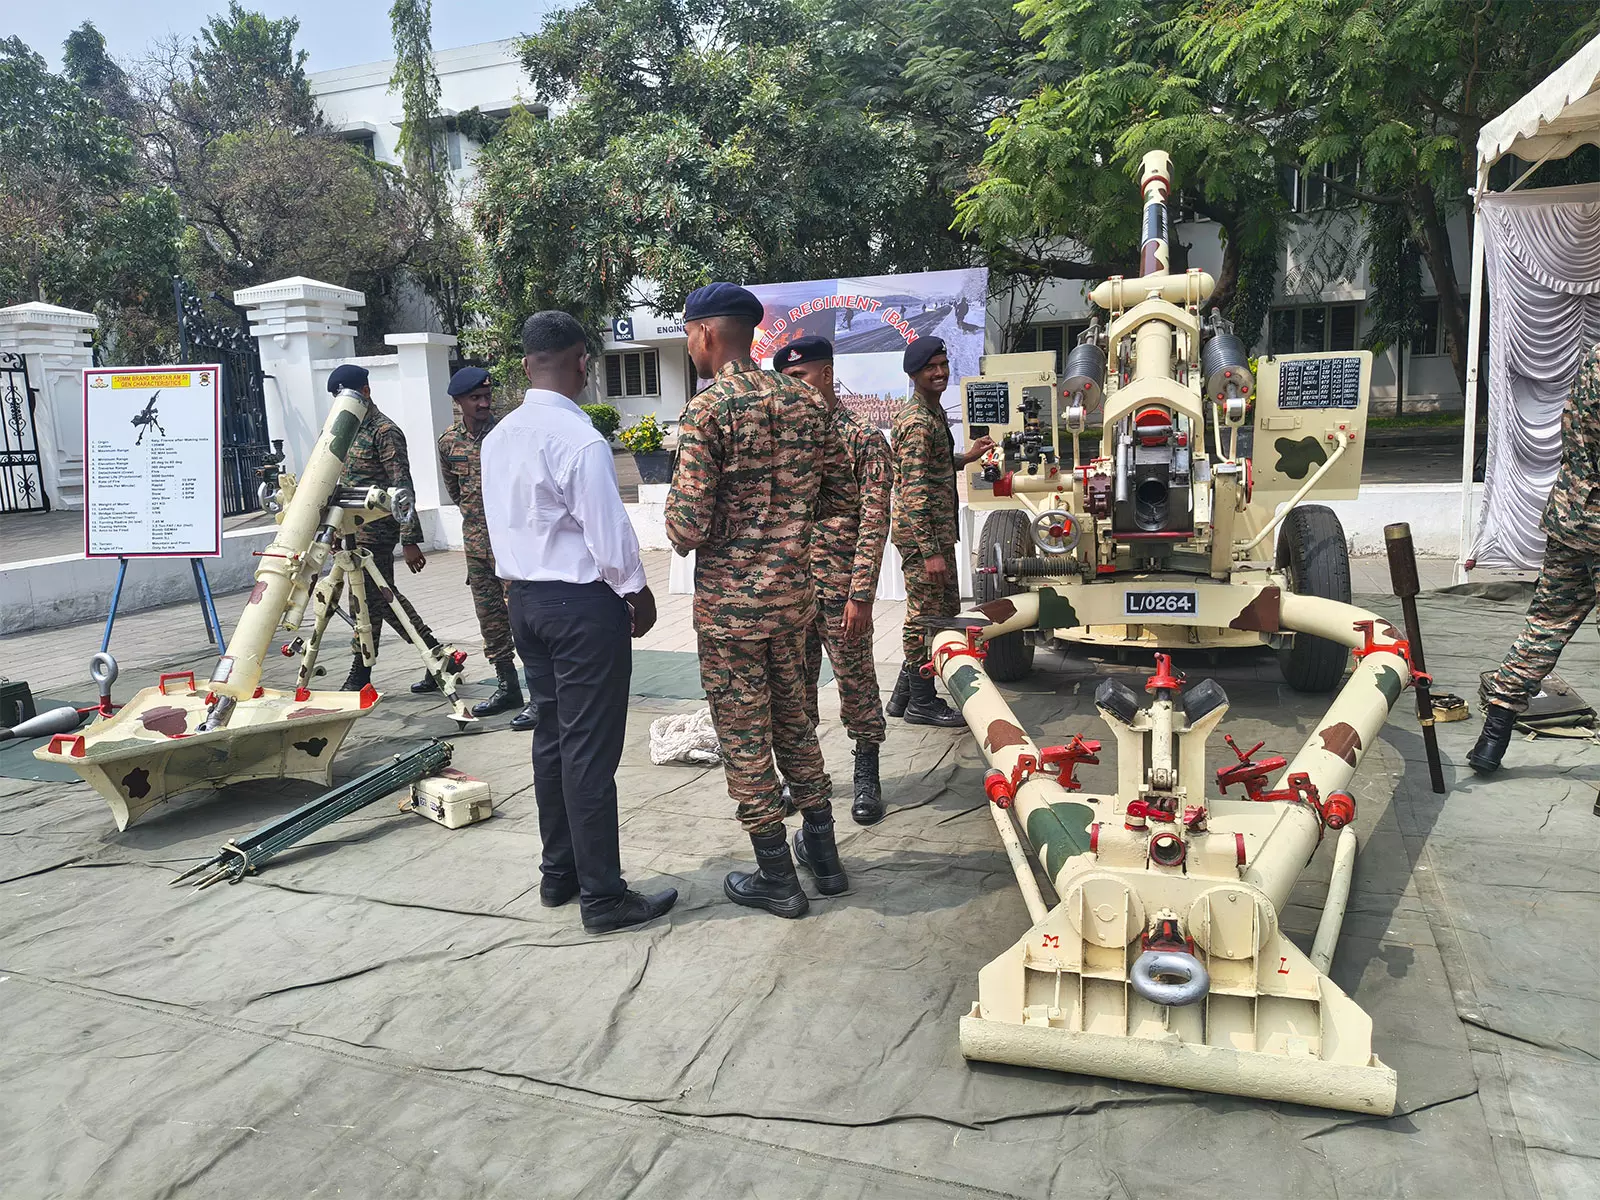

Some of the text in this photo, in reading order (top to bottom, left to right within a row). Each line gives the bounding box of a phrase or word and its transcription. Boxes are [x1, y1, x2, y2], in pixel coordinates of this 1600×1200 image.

[616, 319, 629, 334] C
[657, 325, 686, 334] ENGIN
[749, 295, 920, 364] FIELD REGIMENT (BAN
[1130, 595, 1192, 611] L/0264
[1041, 933, 1060, 949] M
[1277, 957, 1291, 975] L
